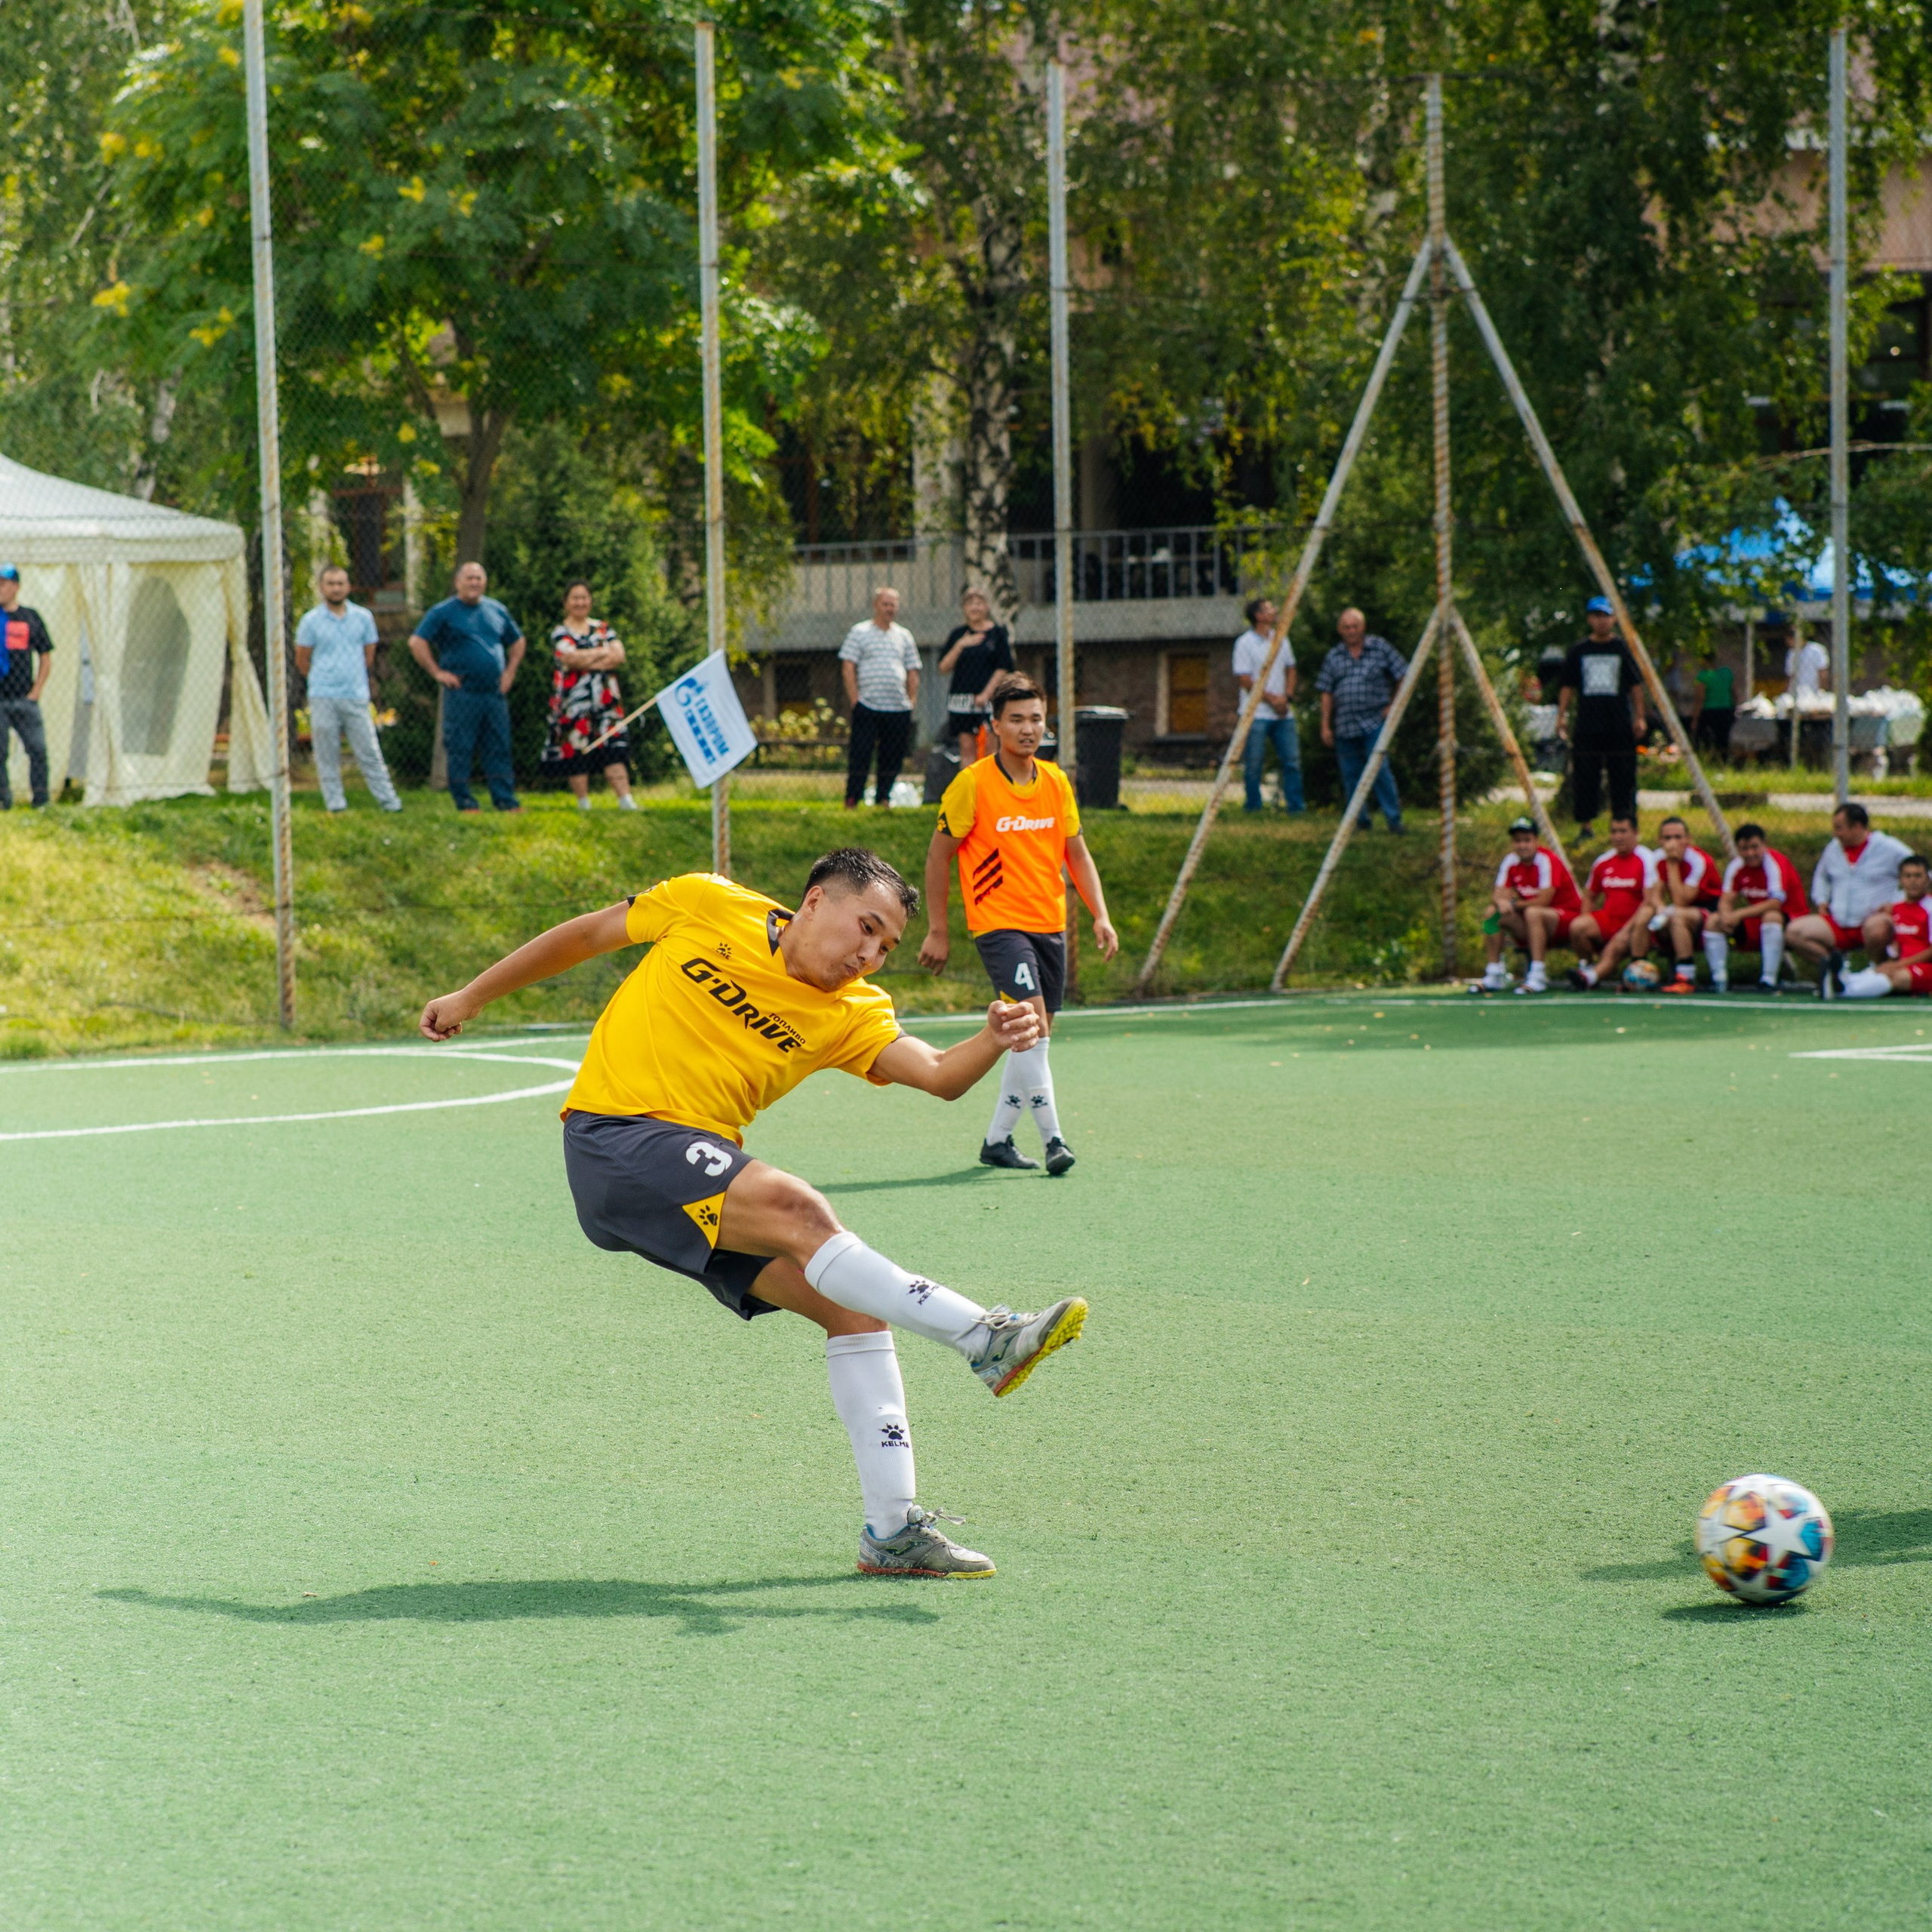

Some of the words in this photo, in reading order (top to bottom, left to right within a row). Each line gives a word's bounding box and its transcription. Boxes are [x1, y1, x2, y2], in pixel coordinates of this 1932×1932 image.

[1014, 961, 1035, 991] 4
[769, 1013, 806, 1044] ТОПЛИВО
[685, 1141, 733, 1177] 3
